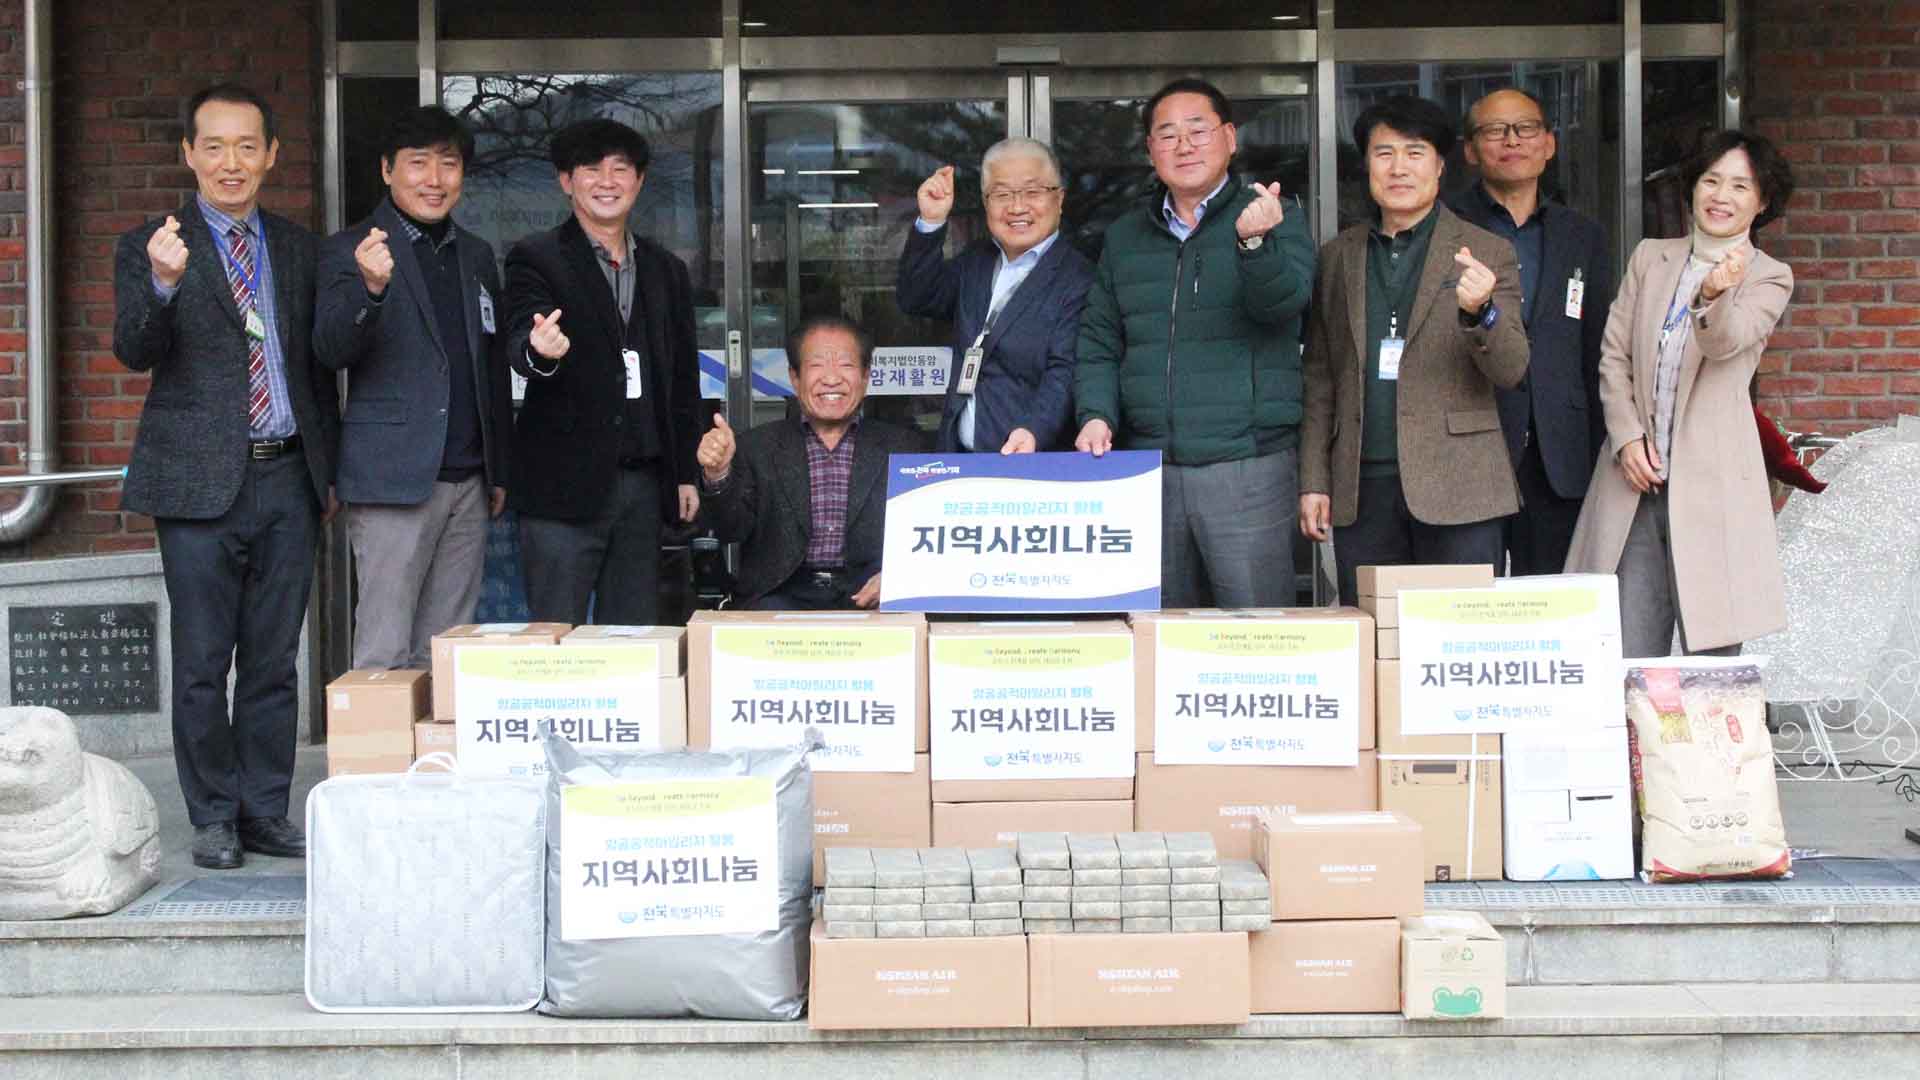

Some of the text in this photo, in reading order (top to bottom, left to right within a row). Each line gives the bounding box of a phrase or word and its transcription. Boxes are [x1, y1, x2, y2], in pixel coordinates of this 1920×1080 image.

[911, 524, 1133, 555] 지역사회나눔
[992, 571, 1072, 587] 전북특별자치도
[1421, 659, 1584, 688] 지역사회나눔
[731, 699, 895, 726] 지역사회나눔
[1175, 693, 1339, 719] 지역사회나눔
[951, 707, 1116, 734] 지역사회나눔
[582, 855, 758, 888] 지역사회나눔
